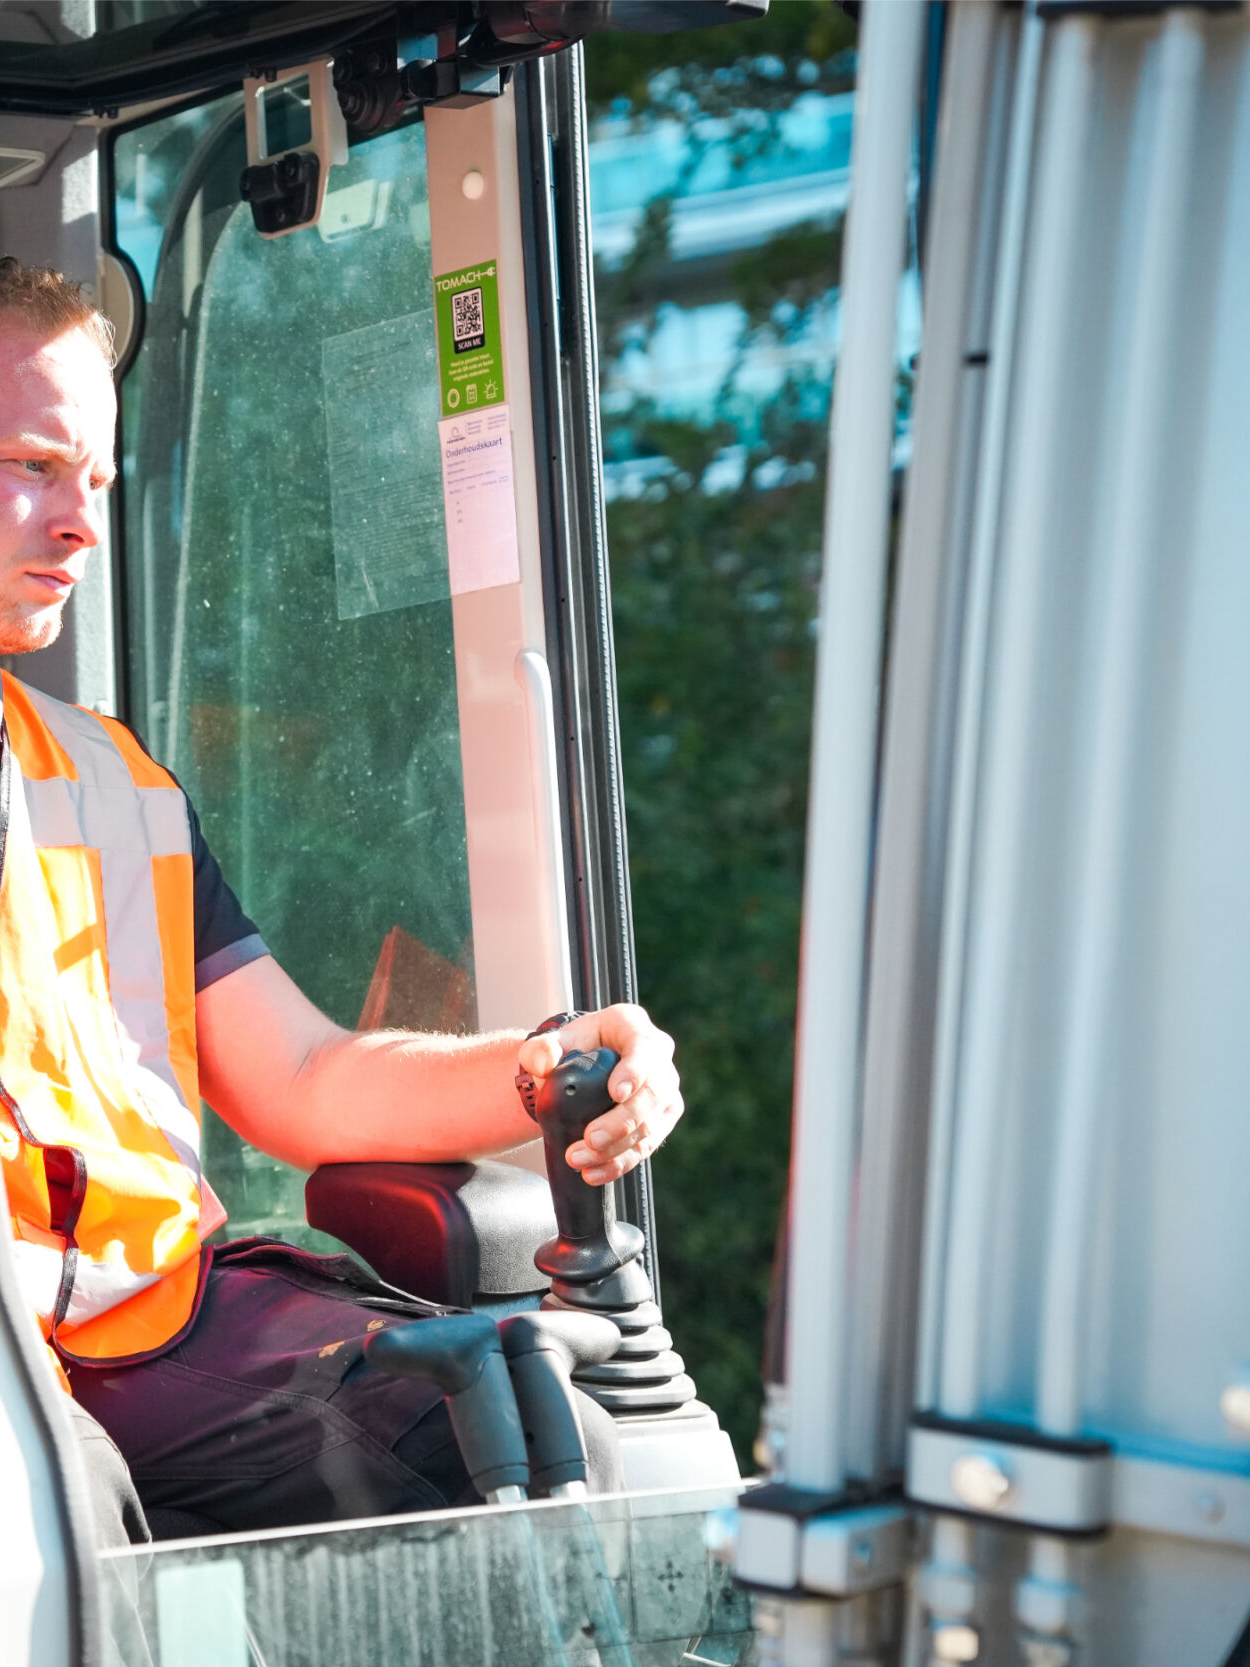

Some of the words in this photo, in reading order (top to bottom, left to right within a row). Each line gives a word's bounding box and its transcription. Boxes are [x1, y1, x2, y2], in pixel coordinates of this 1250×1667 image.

[436, 270, 481, 292] TOMACH
[458, 340, 472, 350] SCAN
[473, 337, 481, 346] ME
[446, 437, 502, 458] Onderhoudskaart
